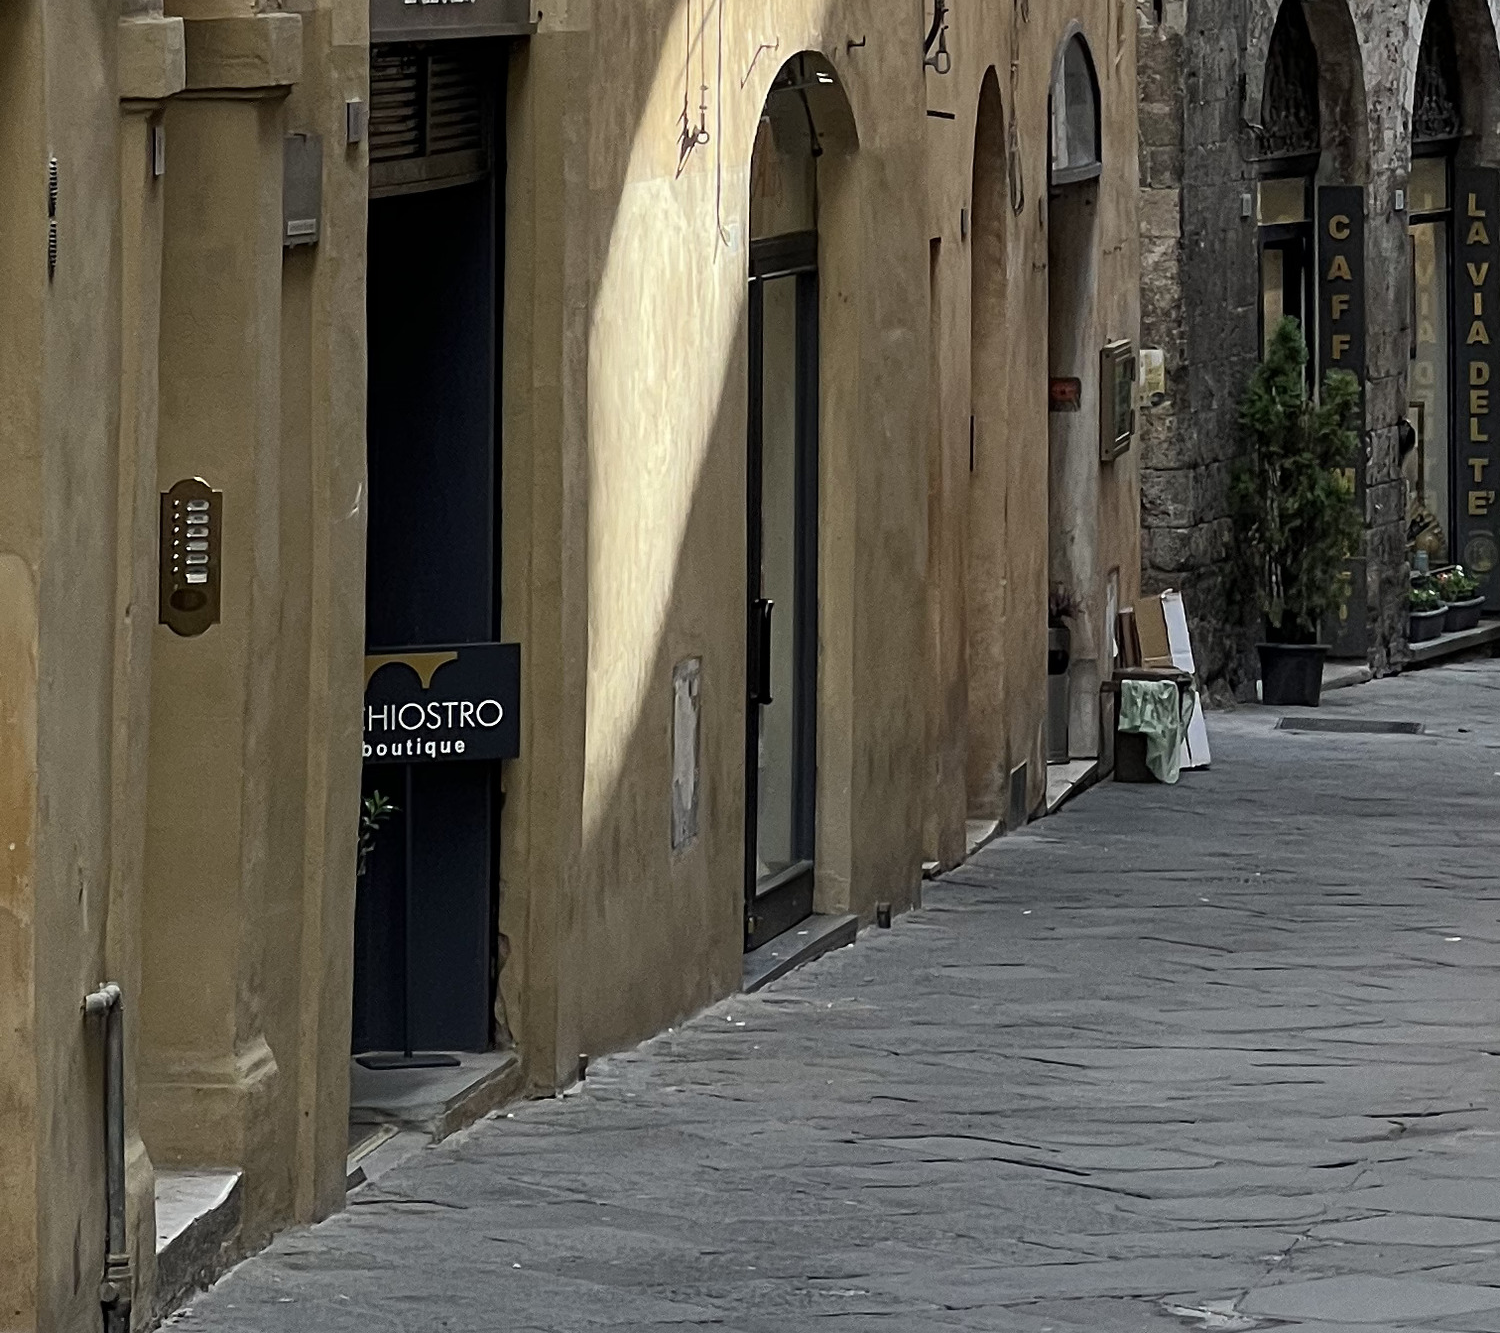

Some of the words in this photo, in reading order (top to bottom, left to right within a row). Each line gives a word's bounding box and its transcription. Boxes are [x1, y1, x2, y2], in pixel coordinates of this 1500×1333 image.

[1466, 192, 1490, 245] LA
[1327, 213, 1353, 360] CAFF
[1466, 262, 1490, 345] VIA
[1468, 361, 1490, 442] DEL
[362, 738, 466, 758] boutique
[363, 700, 503, 731] HIOSTRO
